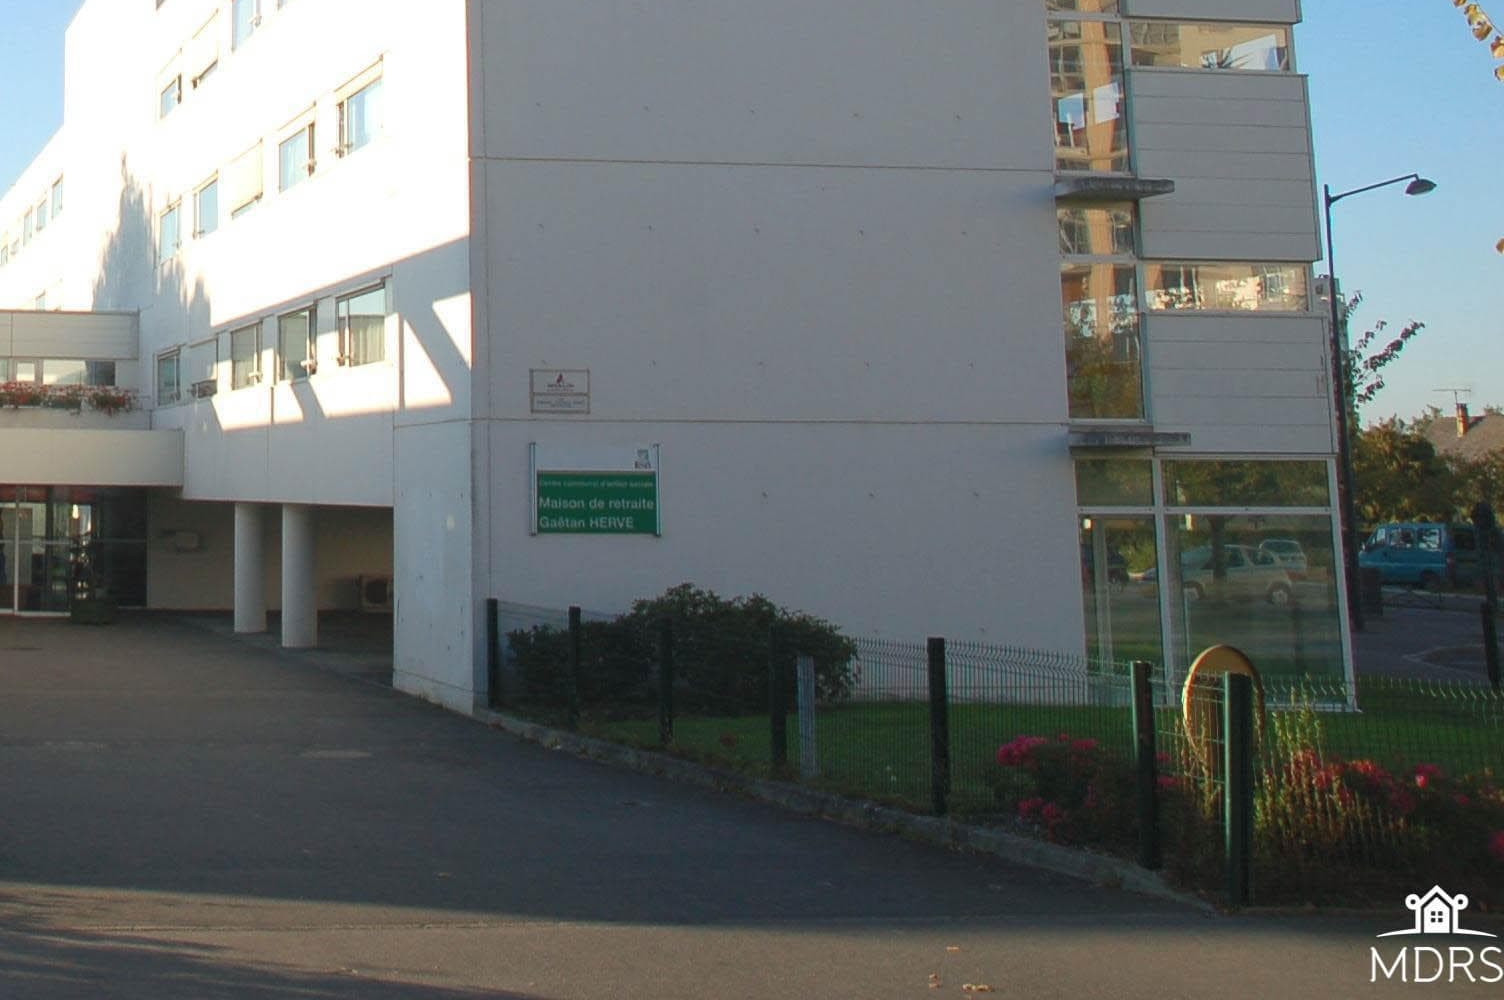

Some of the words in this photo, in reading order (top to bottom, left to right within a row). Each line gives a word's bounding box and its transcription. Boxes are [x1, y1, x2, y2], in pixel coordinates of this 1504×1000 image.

[538, 497, 585, 510] Maison
[588, 498, 605, 510] de
[608, 498, 655, 510] retraite
